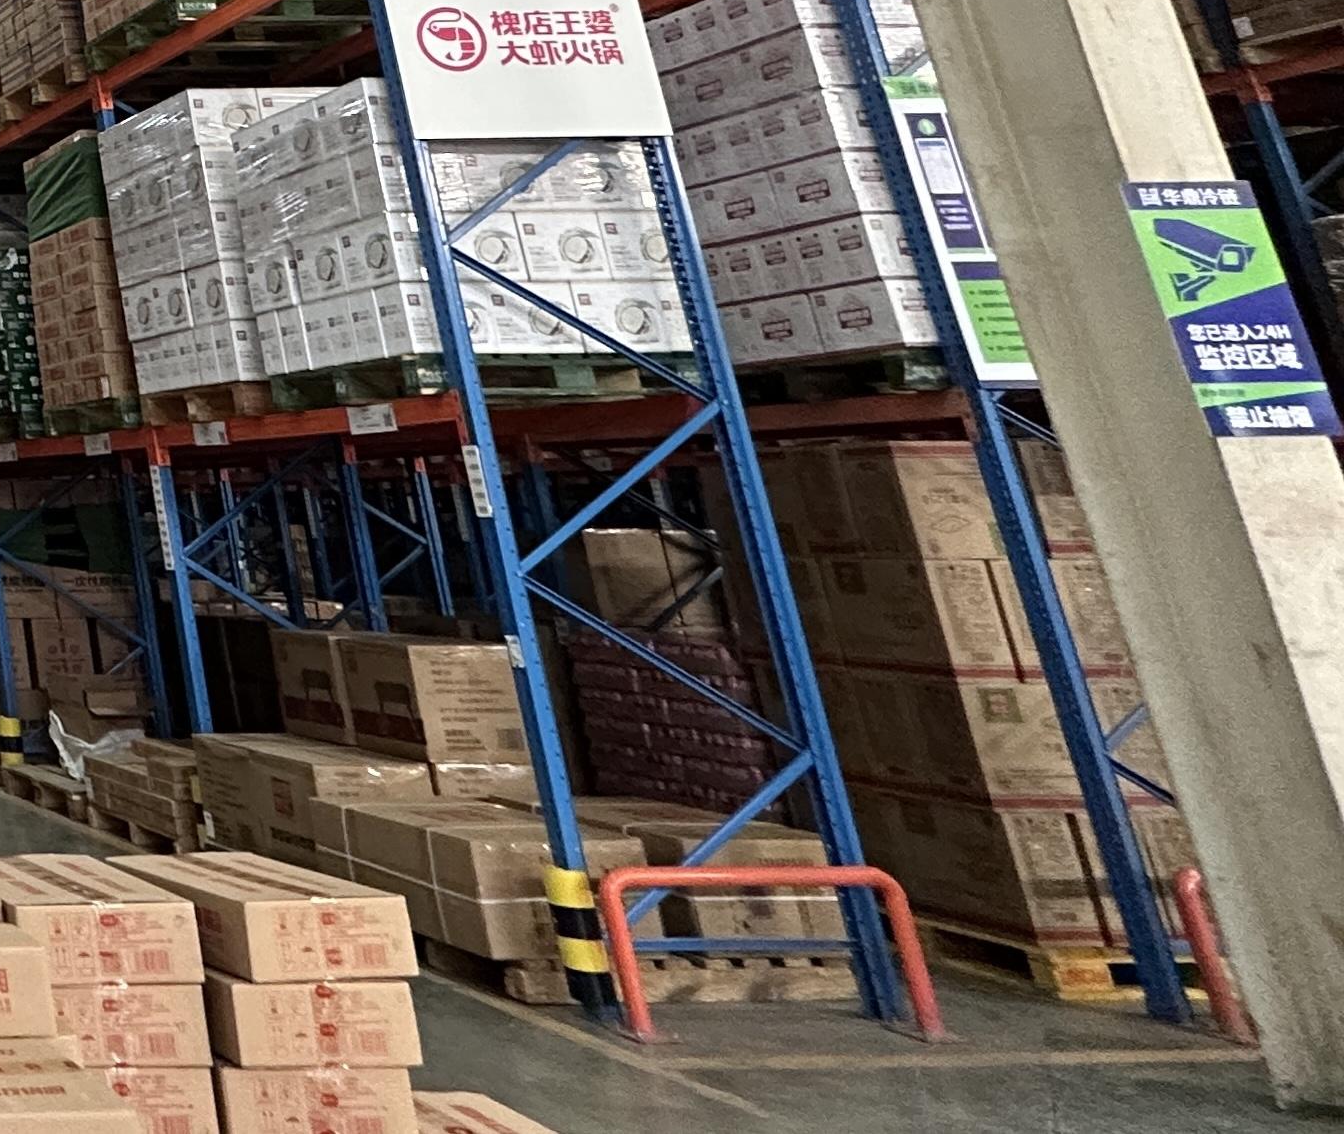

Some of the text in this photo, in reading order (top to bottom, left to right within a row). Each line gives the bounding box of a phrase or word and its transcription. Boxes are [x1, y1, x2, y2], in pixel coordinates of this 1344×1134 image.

[490, 10, 616, 36] 槐店王婆
[497, 39, 625, 66] 大虾火锅
[1164, 188, 1240, 207] 华鼎冷链
[1186, 323, 1292, 342] 您已进入24H
[1194, 343, 1303, 371] 监控区域
